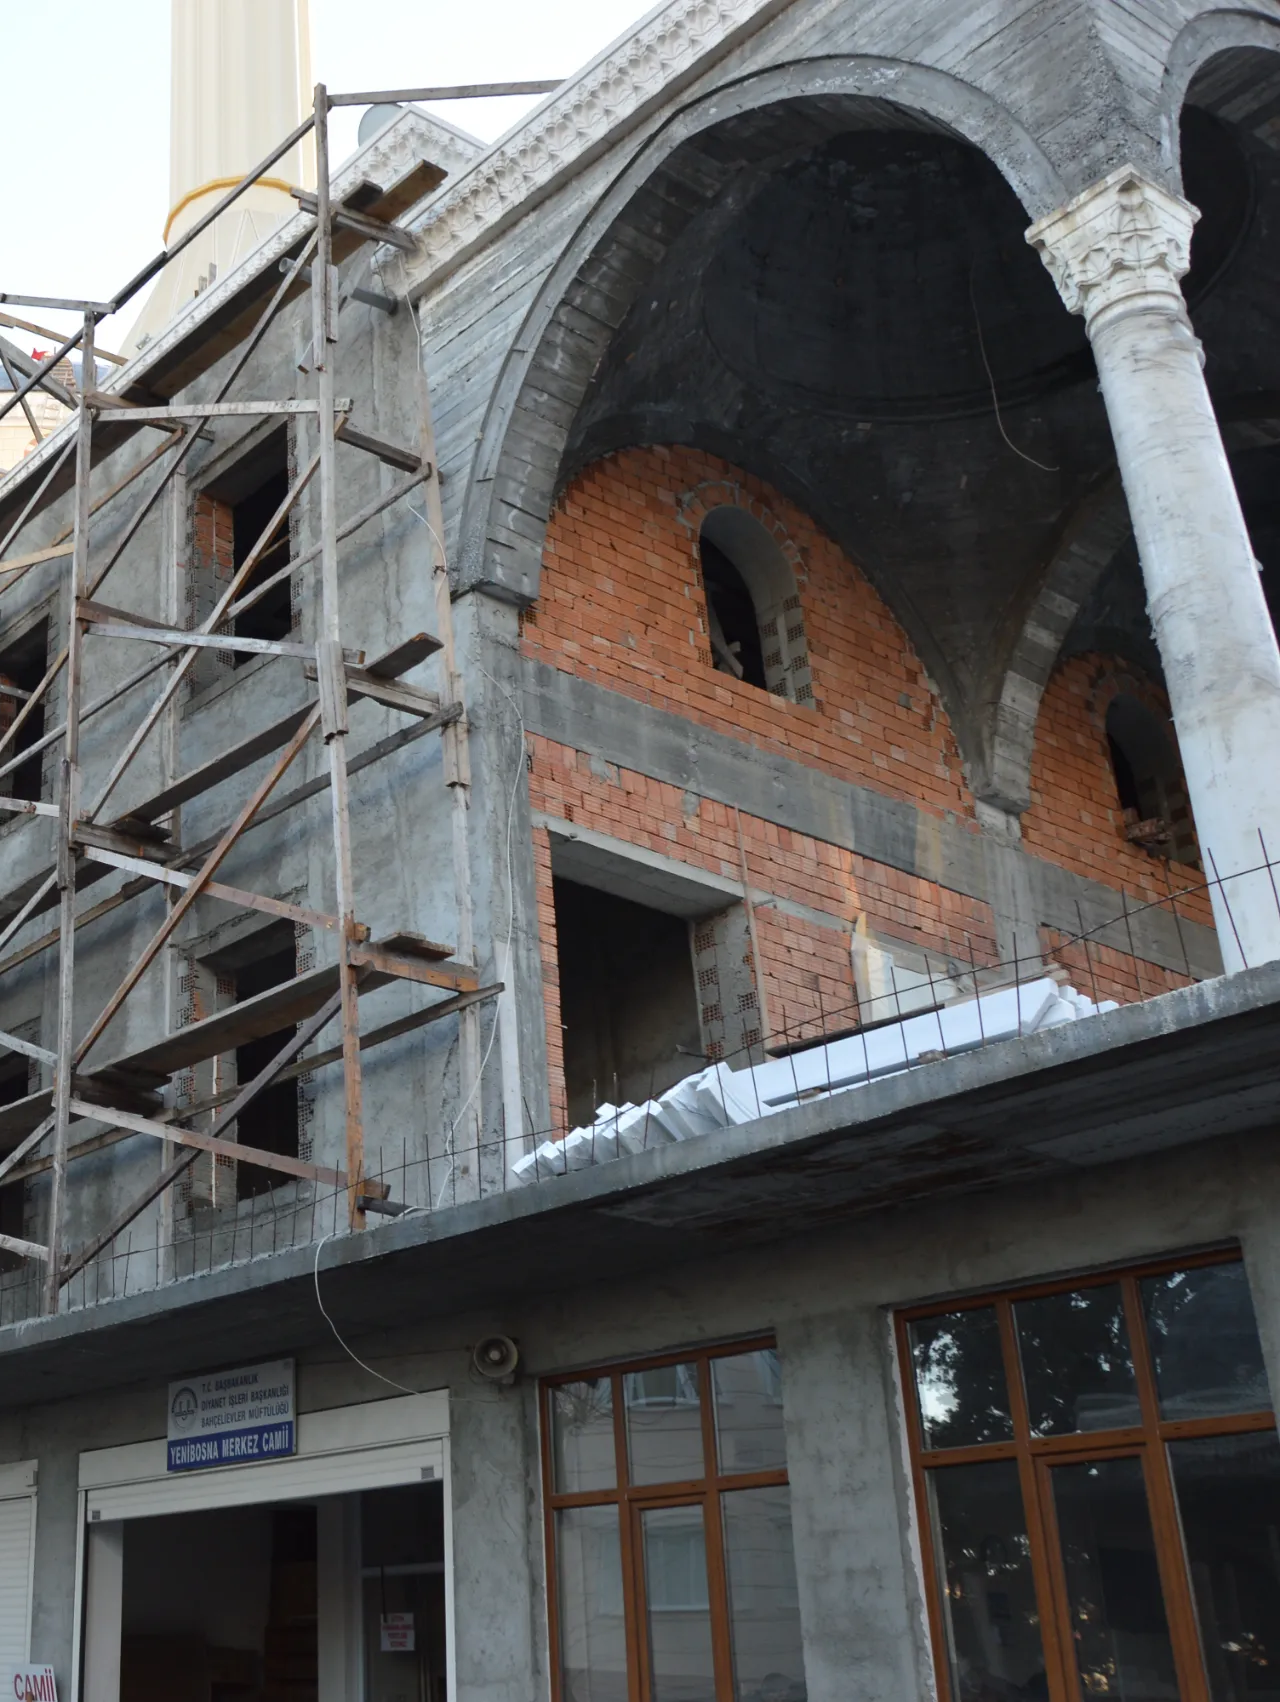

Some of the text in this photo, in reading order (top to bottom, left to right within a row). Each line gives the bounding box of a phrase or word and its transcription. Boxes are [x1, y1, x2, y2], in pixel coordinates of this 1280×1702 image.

[201, 1401, 289, 1428] BAHÇELİEVLER MÜFTÜLÜĞÜ
[170, 1424, 289, 1465] YENİBOSNA MERKEZ CAMİİ
